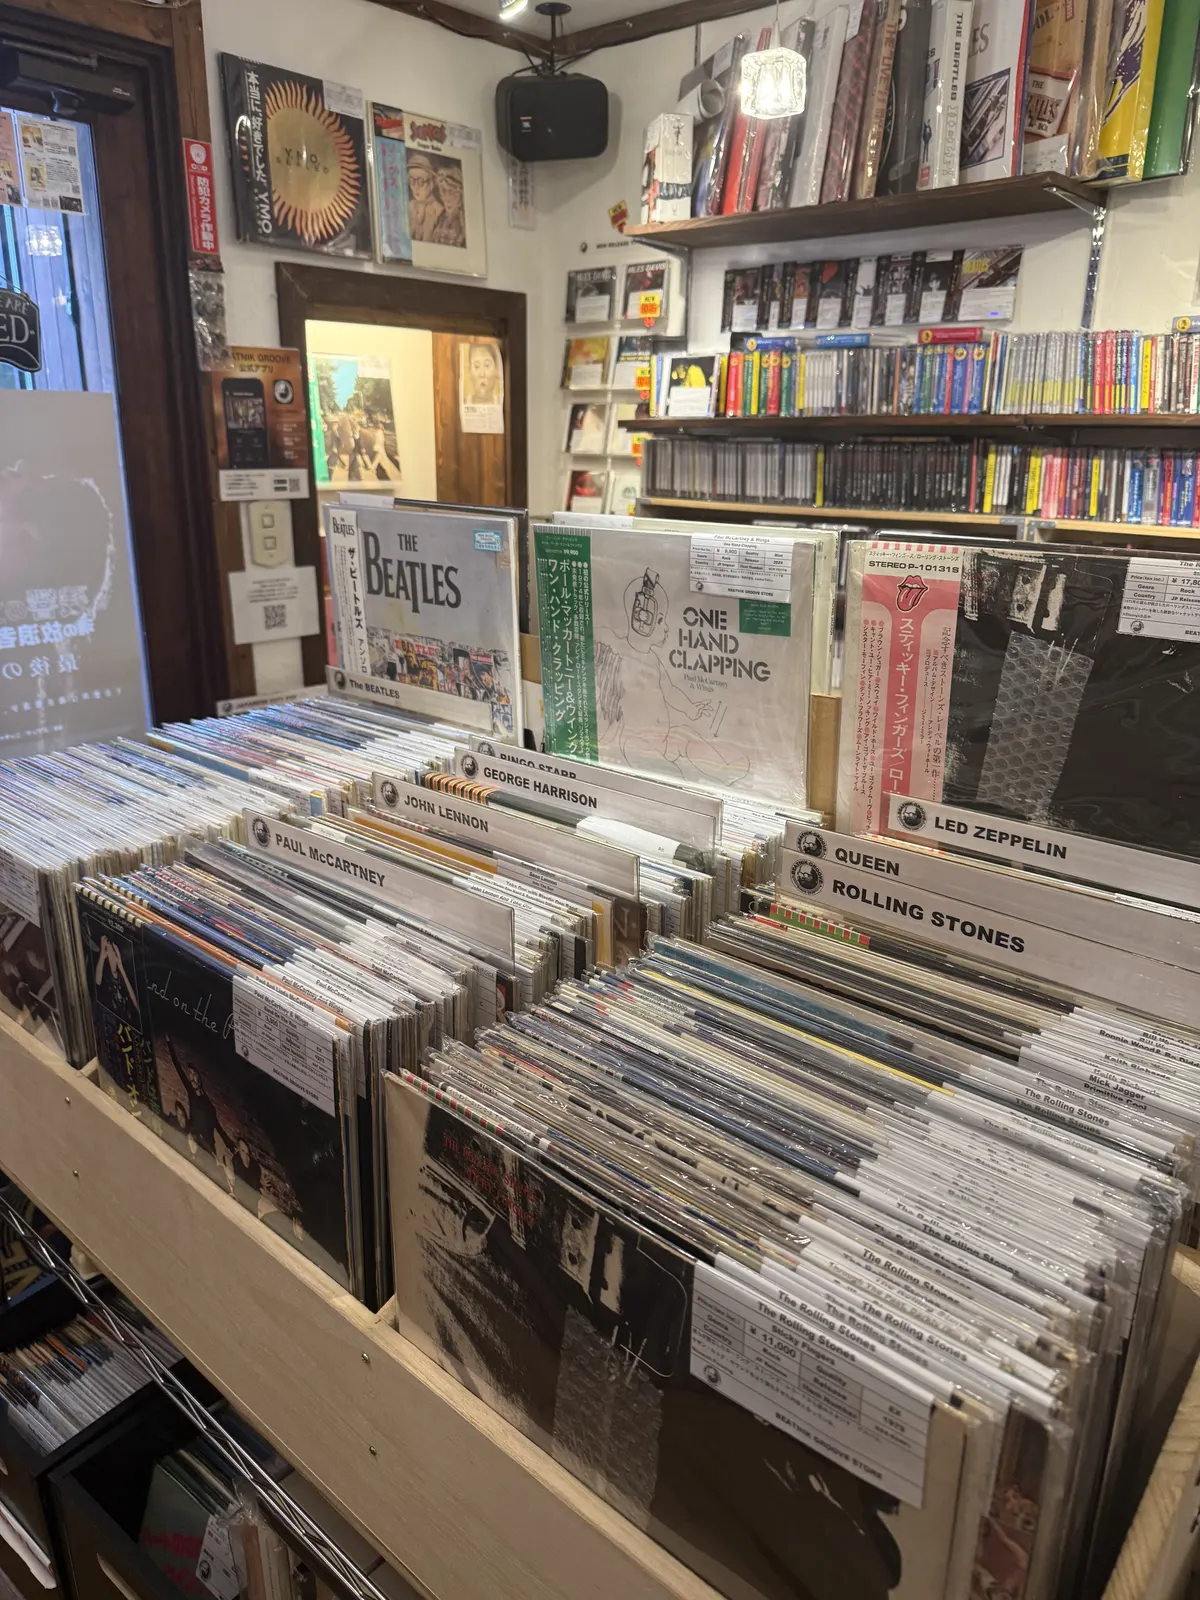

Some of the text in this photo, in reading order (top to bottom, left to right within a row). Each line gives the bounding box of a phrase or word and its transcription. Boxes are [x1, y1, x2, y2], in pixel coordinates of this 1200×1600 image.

[1032, 80, 1044, 89] THE
[197, 176, 215, 250] 防犯カメラ作動中
[258, 191, 272, 234] YMO
[645, 262, 667, 272] DAVIS
[6, 299, 28, 315] ARE
[332, 516, 355, 537] BEATLES
[397, 533, 418, 552] THE
[363, 531, 462, 614] BEATLES
[869, 561, 960, 573] STEREO P-10131S
[348, 547, 363, 629] ザ・ビートルズ
[683, 606, 727, 631] ONE
[548, 559, 566, 722] ワン・ハンド・クラッピング
[679, 628, 739, 654] HAND
[669, 649, 771, 682] CLAPPING
[349, 680, 400, 699] The BEATLES
[684, 673, 728, 688] Paul McCartney
[484, 766, 597, 809] GEORGE HARRISON
[404, 795, 489, 833] JOHN LENNON
[935, 816, 1067, 859] LED ZEPPELIN
[276, 833, 386, 887] PAUL McCARTNEY
[835, 848, 900, 876] QUEEN
[482, 888, 500, 898] Lennon
[832, 879, 1025, 953] ROLLING STONES
[254, 990, 264, 1000] Paul
[264, 995, 289, 1016] McCartney
[282, 976, 293, 986] Paul
[294, 982, 318, 999] McCartney
[329, 1000, 344, 1013] Wings
[288, 993, 315, 1012] McCartney
[316, 979, 353, 1003] Paul McCartney
[173, 996, 188, 1013] on
[190, 994, 218, 1033] the
[1036, 1078, 1053, 1088] The
[1084, 1083, 1124, 1101] Primitive
[1089, 1075, 1146, 1100] Mick Jagger
[1015, 1098, 1101, 1134] The Rolling Stones
[1025, 1088, 1110, 1127] The Rolling Stones
[922, 1223, 1021, 1277] The Rolling Stones
[863, 1249, 961, 1304] The Rolling Stones
[703, 1324, 732, 1346] Country
[757, 1302, 857, 1363] The Rolling Stones
[778, 1290, 877, 1352] The Rolling Stones
[826, 1302, 929, 1368] The Rolling Stones
[862, 1301, 968, 1362] The Rolling Stones
[762, 1333, 797, 1358] 11,000
[763, 1347, 781, 1361] Rock
[771, 1324, 836, 1366] Sticky Fingers
[813, 1377, 848, 1400] Release
[816, 1364, 847, 1387] Quality
[824, 1396, 858, 1419] Number
[775, 1411, 884, 1480] BEATNIK GROOVE STORE
